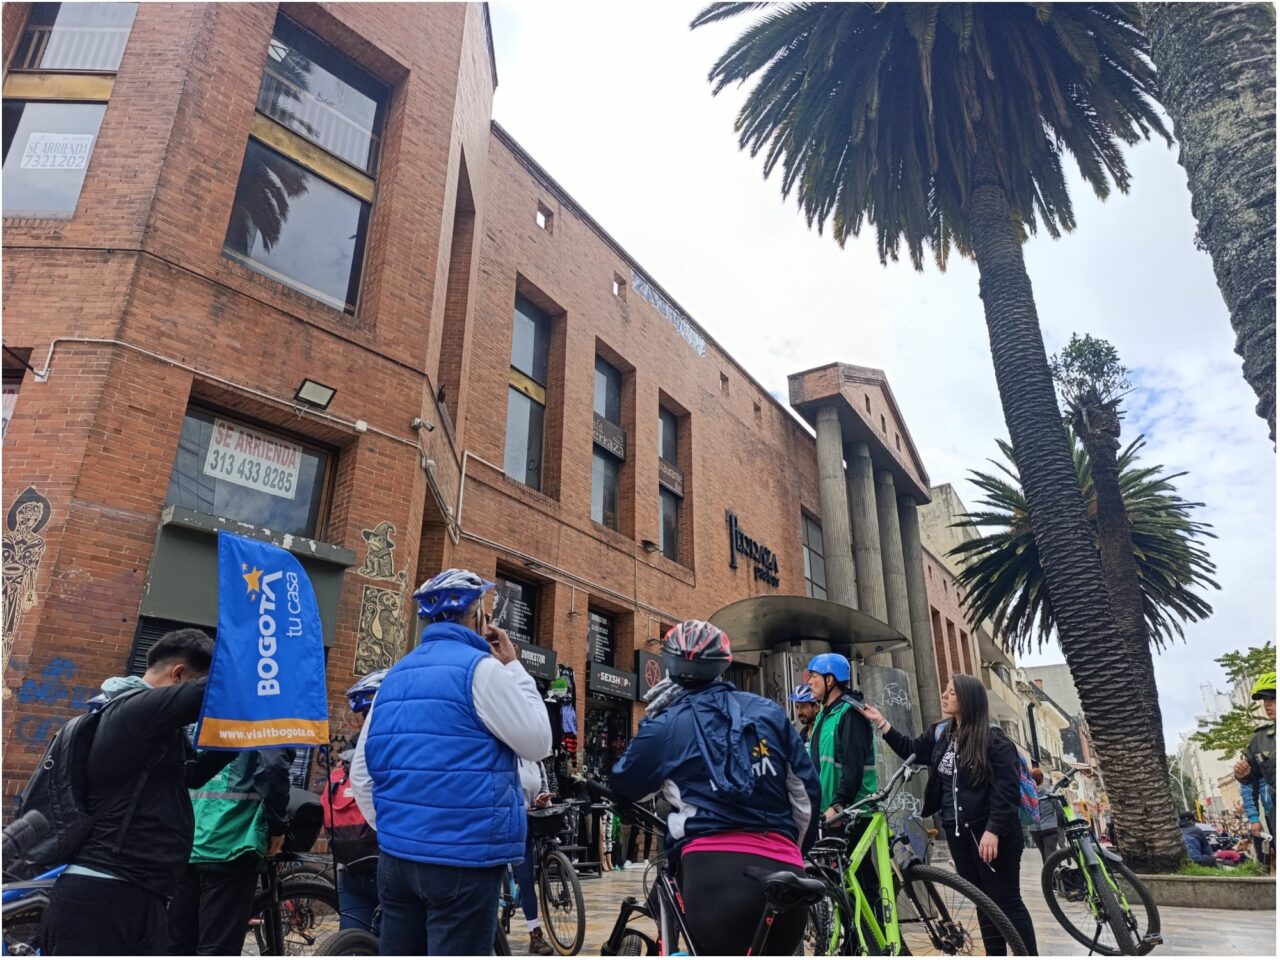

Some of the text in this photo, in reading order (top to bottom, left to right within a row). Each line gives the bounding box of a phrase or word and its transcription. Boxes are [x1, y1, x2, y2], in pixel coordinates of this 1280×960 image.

[24, 155, 86, 168] 7321202
[27, 141, 90, 155] SE ARRIENDA
[215, 422, 298, 469] SE ARRIENDA
[593, 430, 624, 456] erraza
[210, 448, 294, 493] 313 433 8285
[286, 572, 302, 637] tu casa
